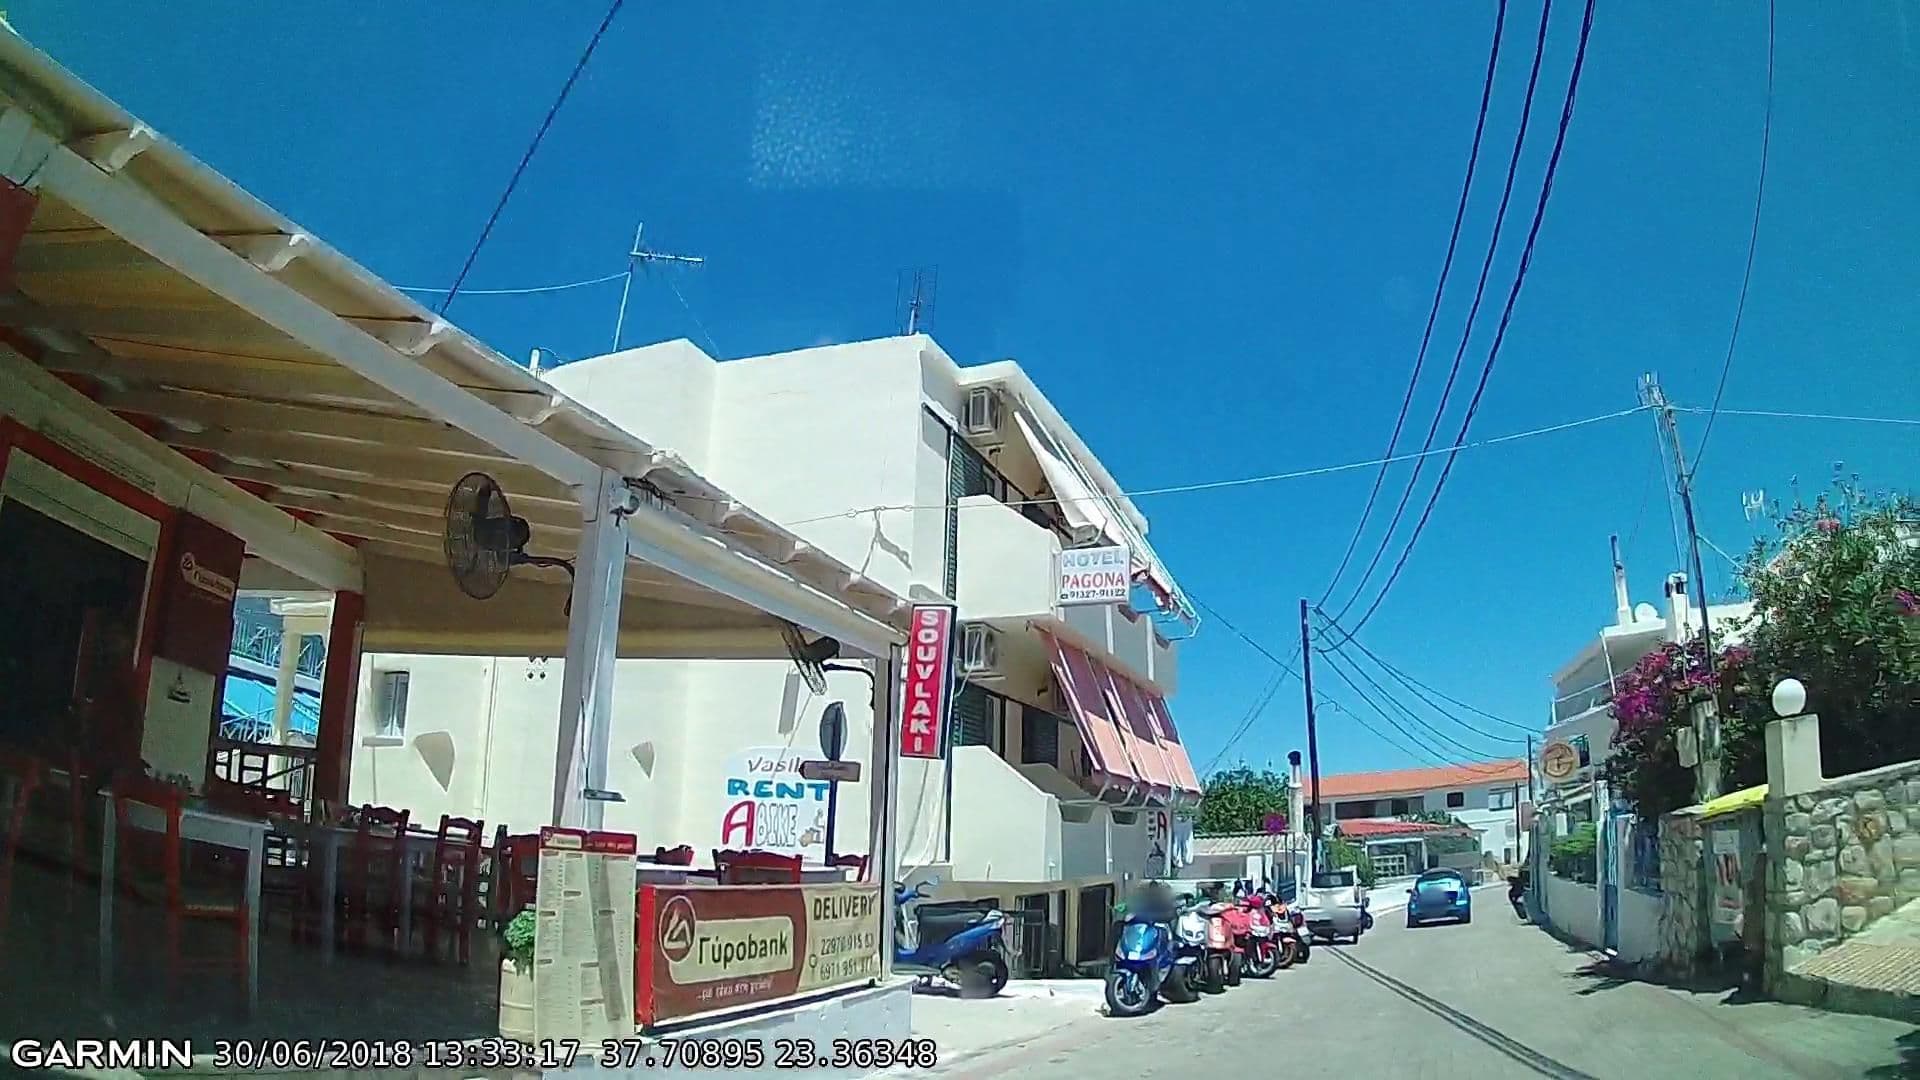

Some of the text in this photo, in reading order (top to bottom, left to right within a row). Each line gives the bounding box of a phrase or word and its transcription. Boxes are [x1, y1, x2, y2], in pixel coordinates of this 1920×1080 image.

[1062, 550, 1124, 567] HOTEL
[1062, 572, 1125, 588] PAGONA
[909, 610, 939, 752] SOUVLAKI
[727, 778, 829, 801] RENT
[722, 800, 798, 847] A BIKE
[814, 895, 877, 920] DELIVERY
